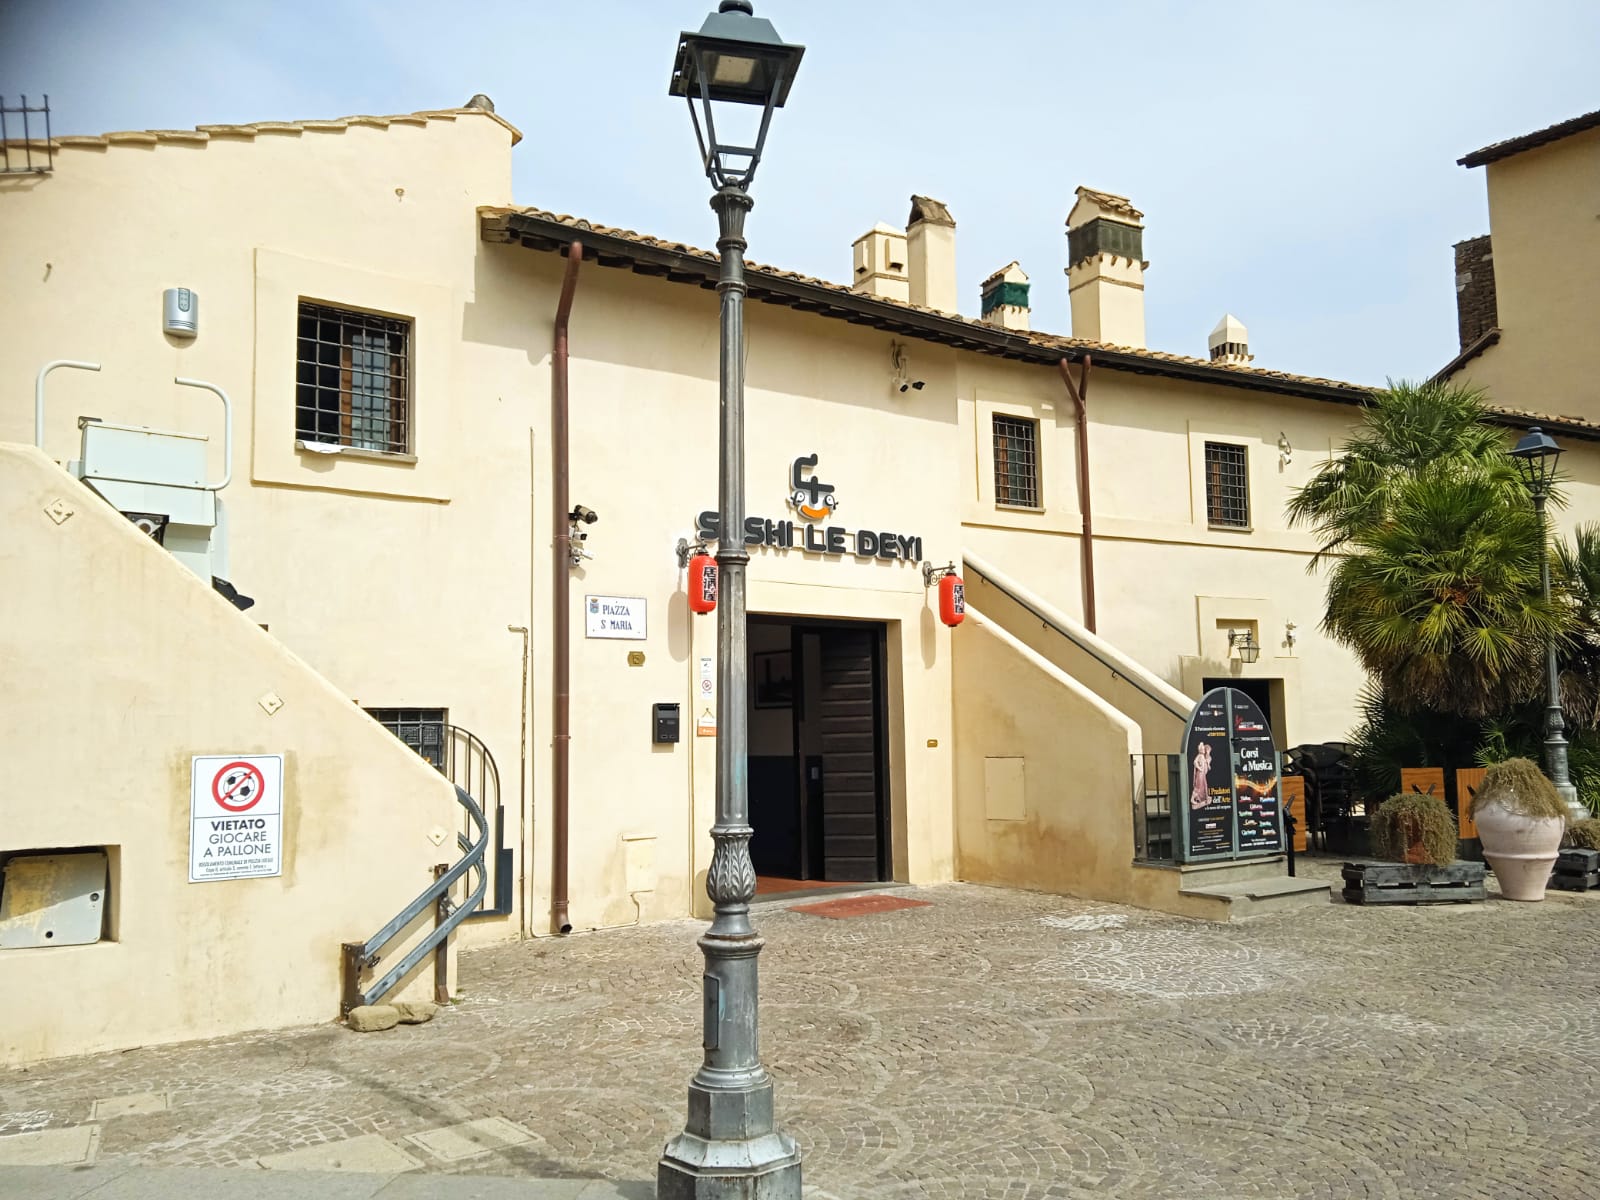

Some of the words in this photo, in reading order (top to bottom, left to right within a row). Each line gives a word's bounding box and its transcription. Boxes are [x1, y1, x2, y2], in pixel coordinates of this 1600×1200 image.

[697, 510, 794, 548] SSHI
[806, 523, 847, 554] LE
[857, 529, 923, 562] DEYI
[602, 604, 630, 616] PIAZZA
[600, 619, 606, 630] S
[610, 620, 632, 631] MARIA
[1240, 747, 1259, 759] Corsi
[1248, 760, 1273, 772] Musica
[210, 818, 266, 832] VIETATO
[208, 831, 267, 845] GIOCARE
[203, 847, 213, 858] A
[217, 843, 272, 857] PALLONE
